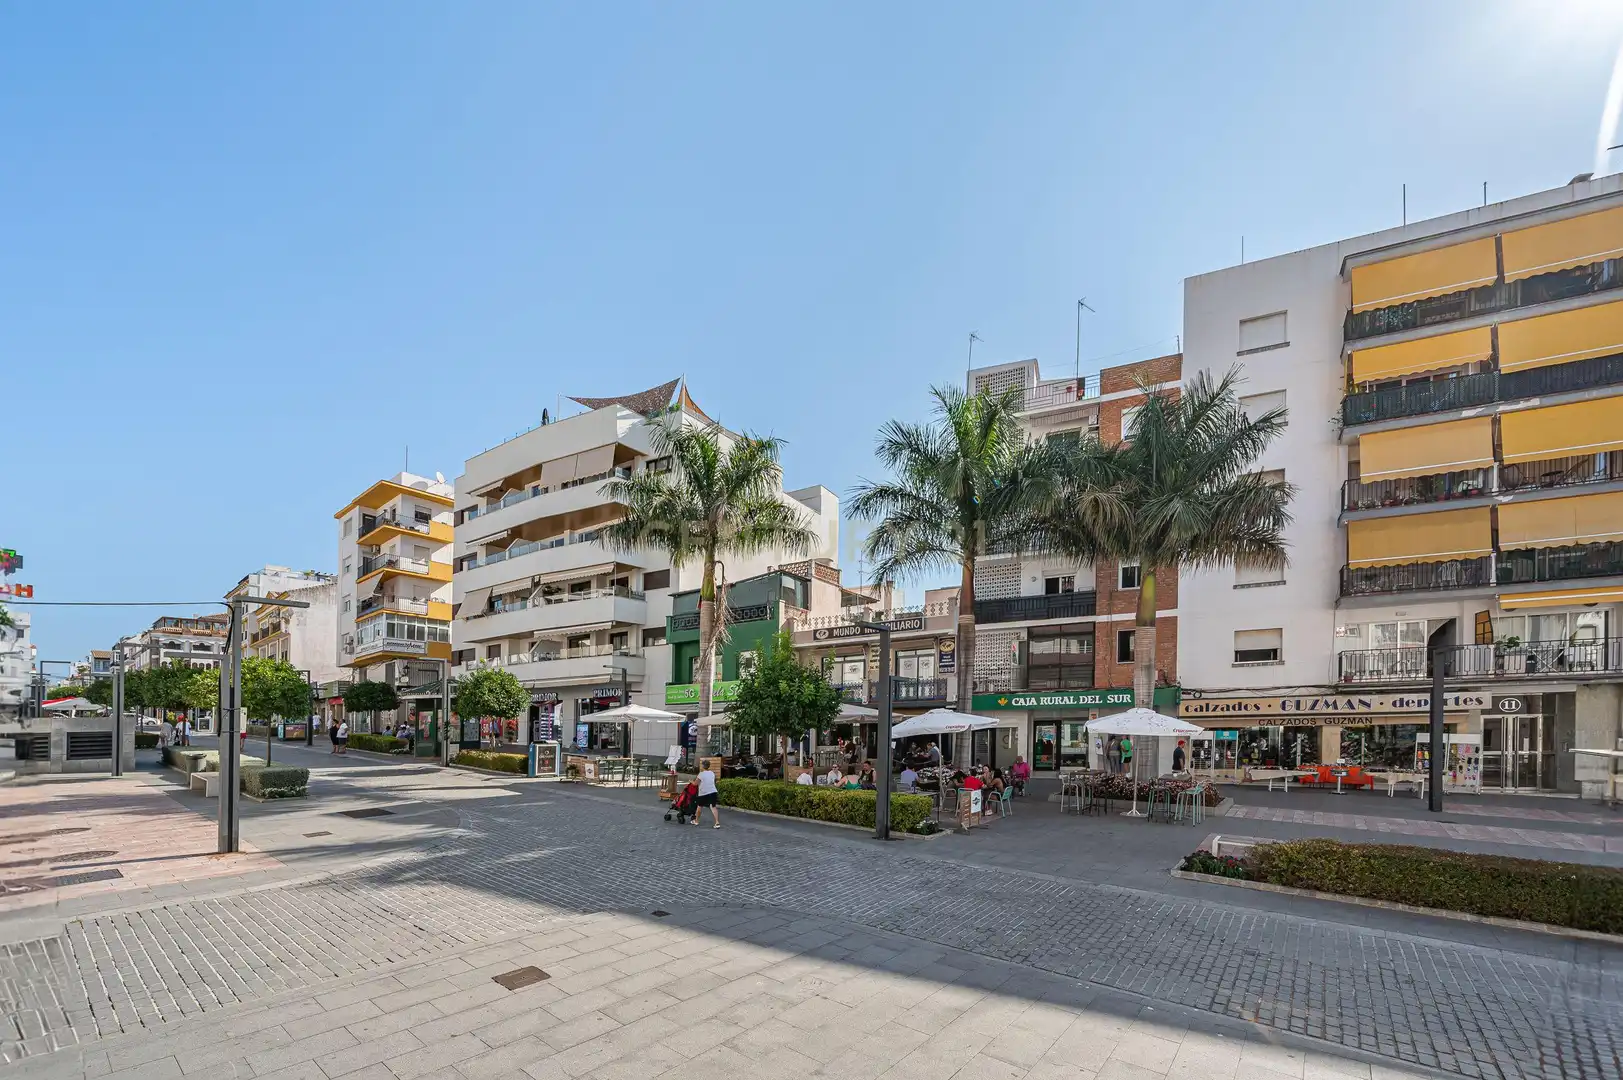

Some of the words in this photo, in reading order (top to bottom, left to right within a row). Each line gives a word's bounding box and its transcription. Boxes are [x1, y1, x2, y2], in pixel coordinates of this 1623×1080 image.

[833, 626, 861, 637] MUNDO
[864, 619, 921, 635] INILIARIO
[684, 688, 695, 698] 5G
[1011, 697, 1037, 706] CAJA
[1040, 696, 1077, 706] RURAL
[1079, 695, 1102, 704] DEL
[1107, 694, 1132, 703] SUR
[1184, 701, 1261, 713] calzados
[1280, 698, 1372, 712] GUZMAN
[1391, 695, 1484, 708] deprtes
[1502, 700, 1516, 710] 11
[1258, 717, 1317, 726] CALZADOS
[1324, 716, 1373, 725] GUZMAN
